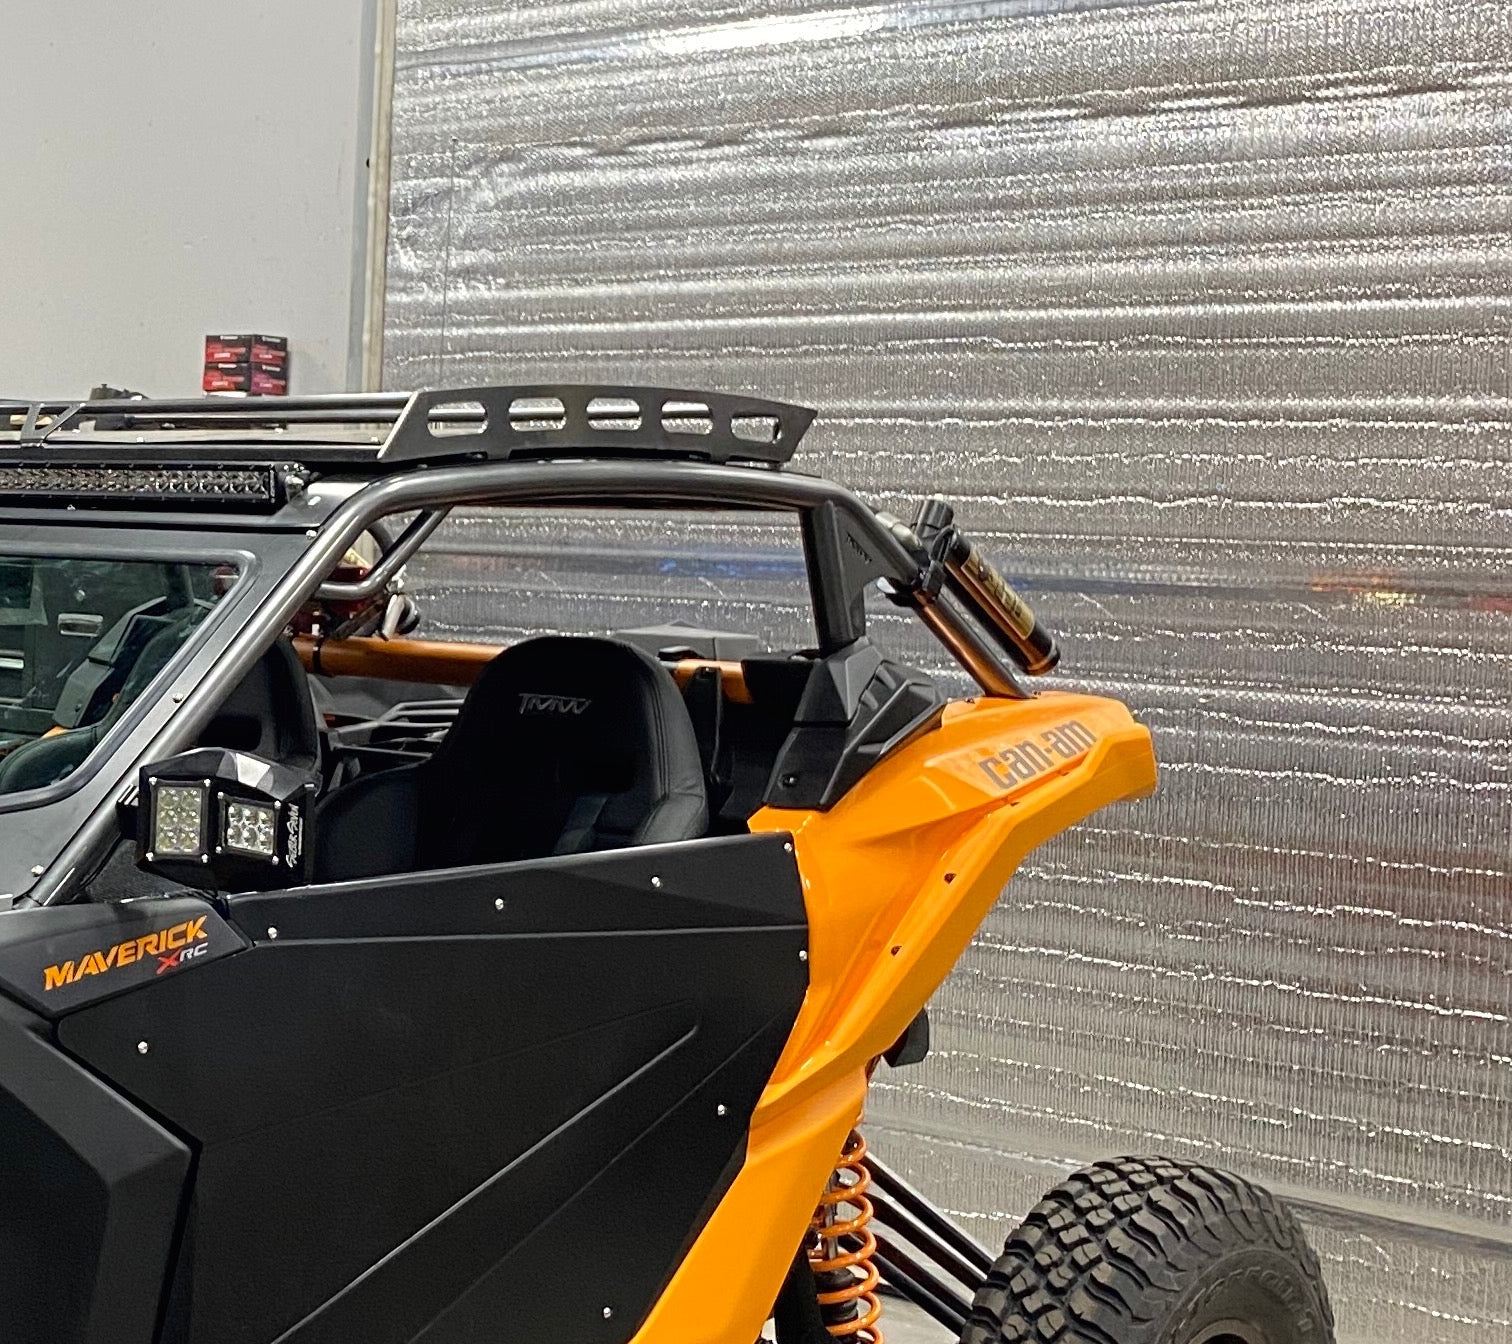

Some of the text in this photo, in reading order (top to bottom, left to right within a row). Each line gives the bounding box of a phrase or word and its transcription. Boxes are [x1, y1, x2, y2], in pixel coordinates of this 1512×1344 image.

[978, 720, 1097, 789] can-am
[43, 914, 208, 991] MAVERICK
[156, 942, 209, 975] XRC
